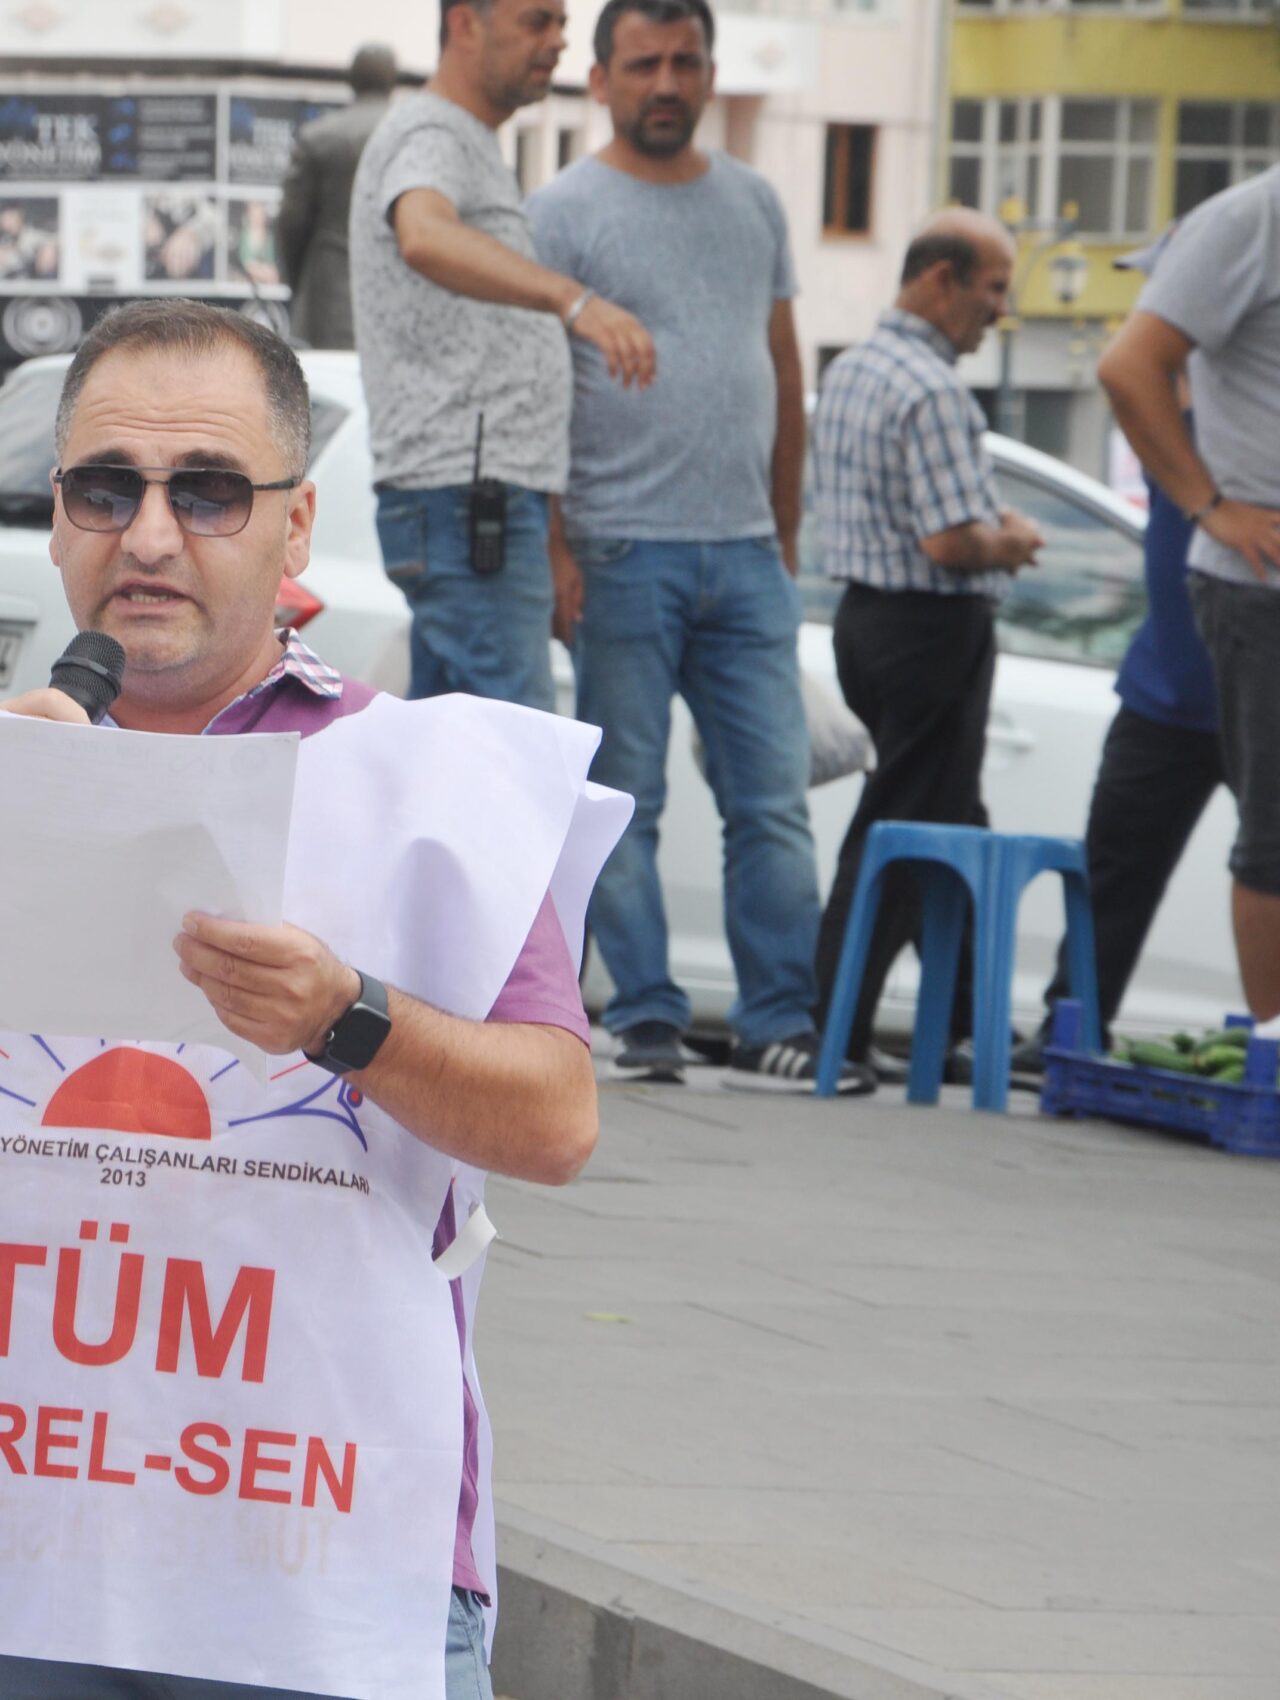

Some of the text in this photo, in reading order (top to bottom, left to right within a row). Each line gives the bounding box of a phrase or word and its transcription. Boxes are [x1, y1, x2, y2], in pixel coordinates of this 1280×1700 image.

[0, 1135, 89, 1159] YÖNETİM
[95, 1143, 237, 1175] ÇALIŞANLARI
[243, 1160, 370, 1195] SENDİKALARI
[100, 1168, 147, 1188] 2013
